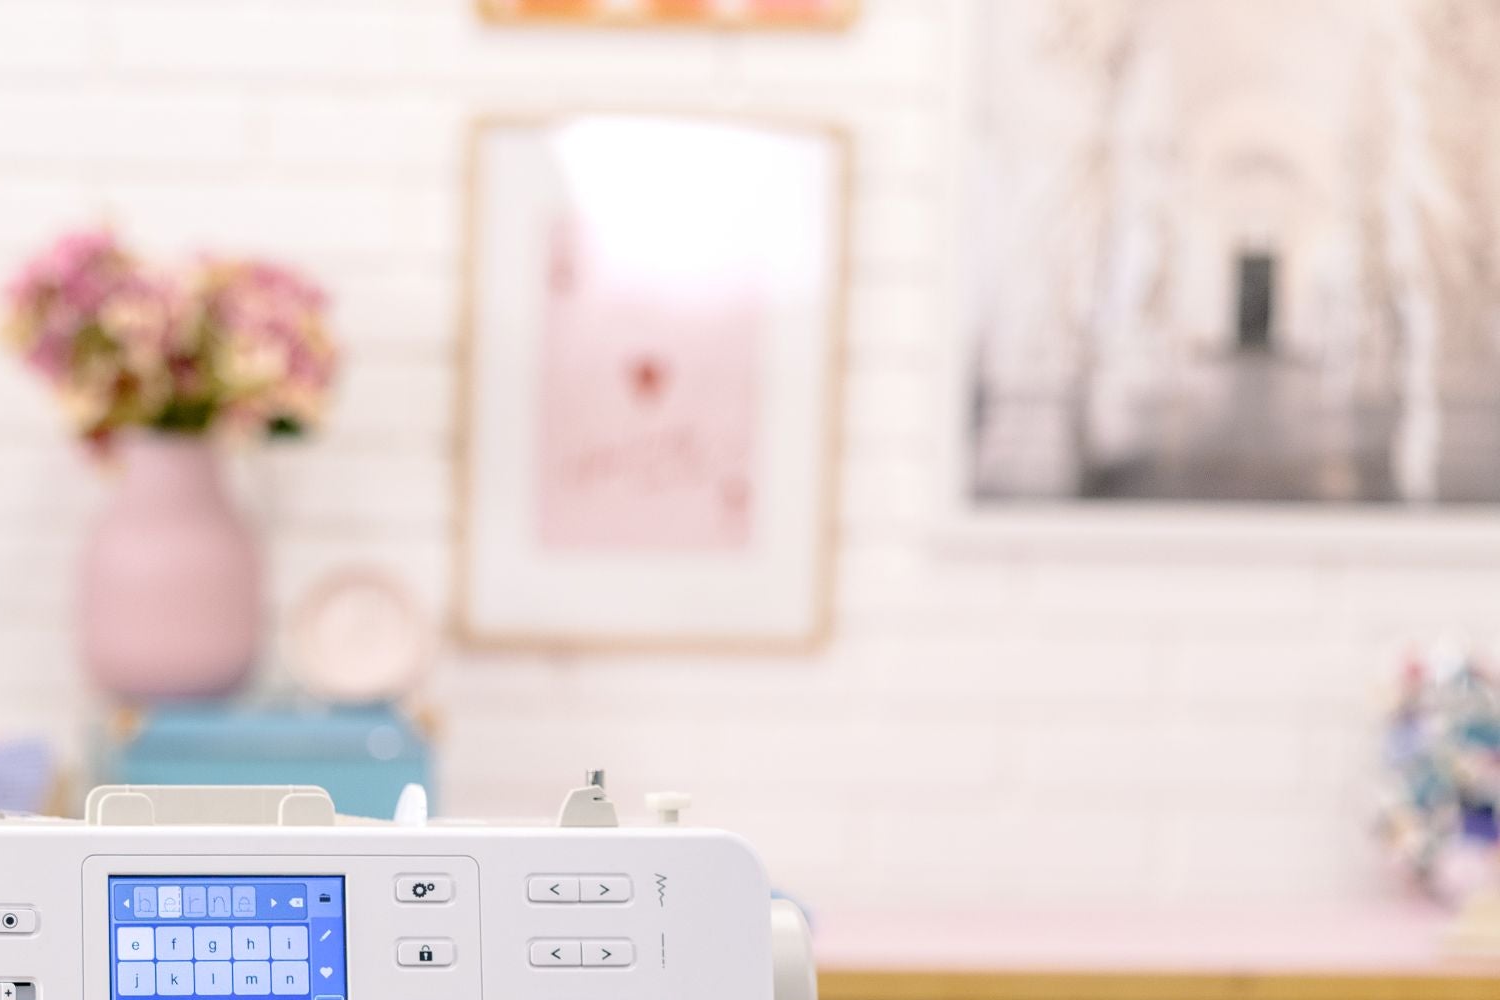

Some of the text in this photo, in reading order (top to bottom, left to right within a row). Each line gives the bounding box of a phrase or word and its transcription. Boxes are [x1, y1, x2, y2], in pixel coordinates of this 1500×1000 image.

[131, 941, 141, 951] e
[171, 938, 177, 950] f
[208, 940, 218, 953] g
[246, 938, 255, 950] h
[134, 973, 139, 988] j
[170, 973, 179, 985] k
[245, 975, 258, 985] m
[286, 975, 294, 985] n
